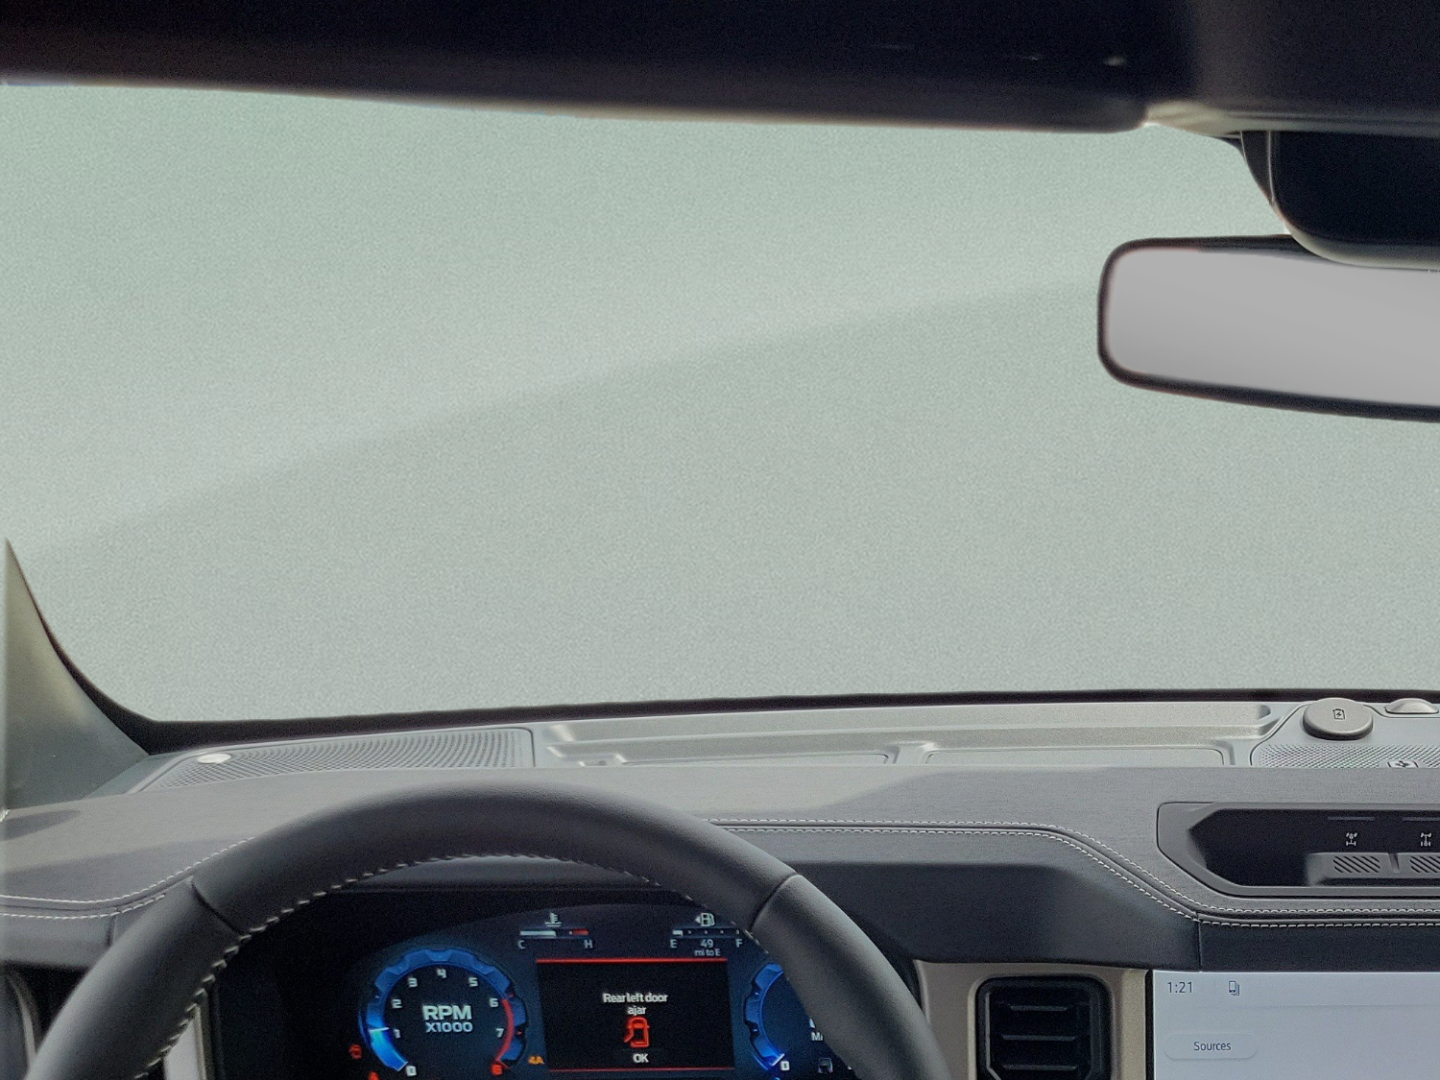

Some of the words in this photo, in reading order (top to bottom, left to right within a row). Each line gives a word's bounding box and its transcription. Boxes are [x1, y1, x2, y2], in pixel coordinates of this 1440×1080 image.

[517, 939, 526, 949] C
[584, 939, 593, 949] H
[670, 938, 677, 948] E
[700, 938, 714, 948] 49
[735, 938, 743, 948] F
[436, 968, 447, 979] 4
[407, 977, 418, 988] 3
[468, 977, 478, 988] 5
[1166, 981, 1194, 995] 1:21
[602, 992, 626, 1003] Rear
[627, 992, 644, 1003] left
[645, 992, 668, 1003] door
[391, 999, 403, 1009] 2
[422, 1005, 472, 1021] RPM
[627, 1005, 646, 1016] ajar
[425, 1022, 473, 1033] X1000
[495, 1028, 504, 1038] 7
[393, 1029, 400, 1039] 1
[1193, 1040, 1231, 1053] Sources
[632, 1052, 649, 1063] OK
[405, 1065, 417, 1077] 0
